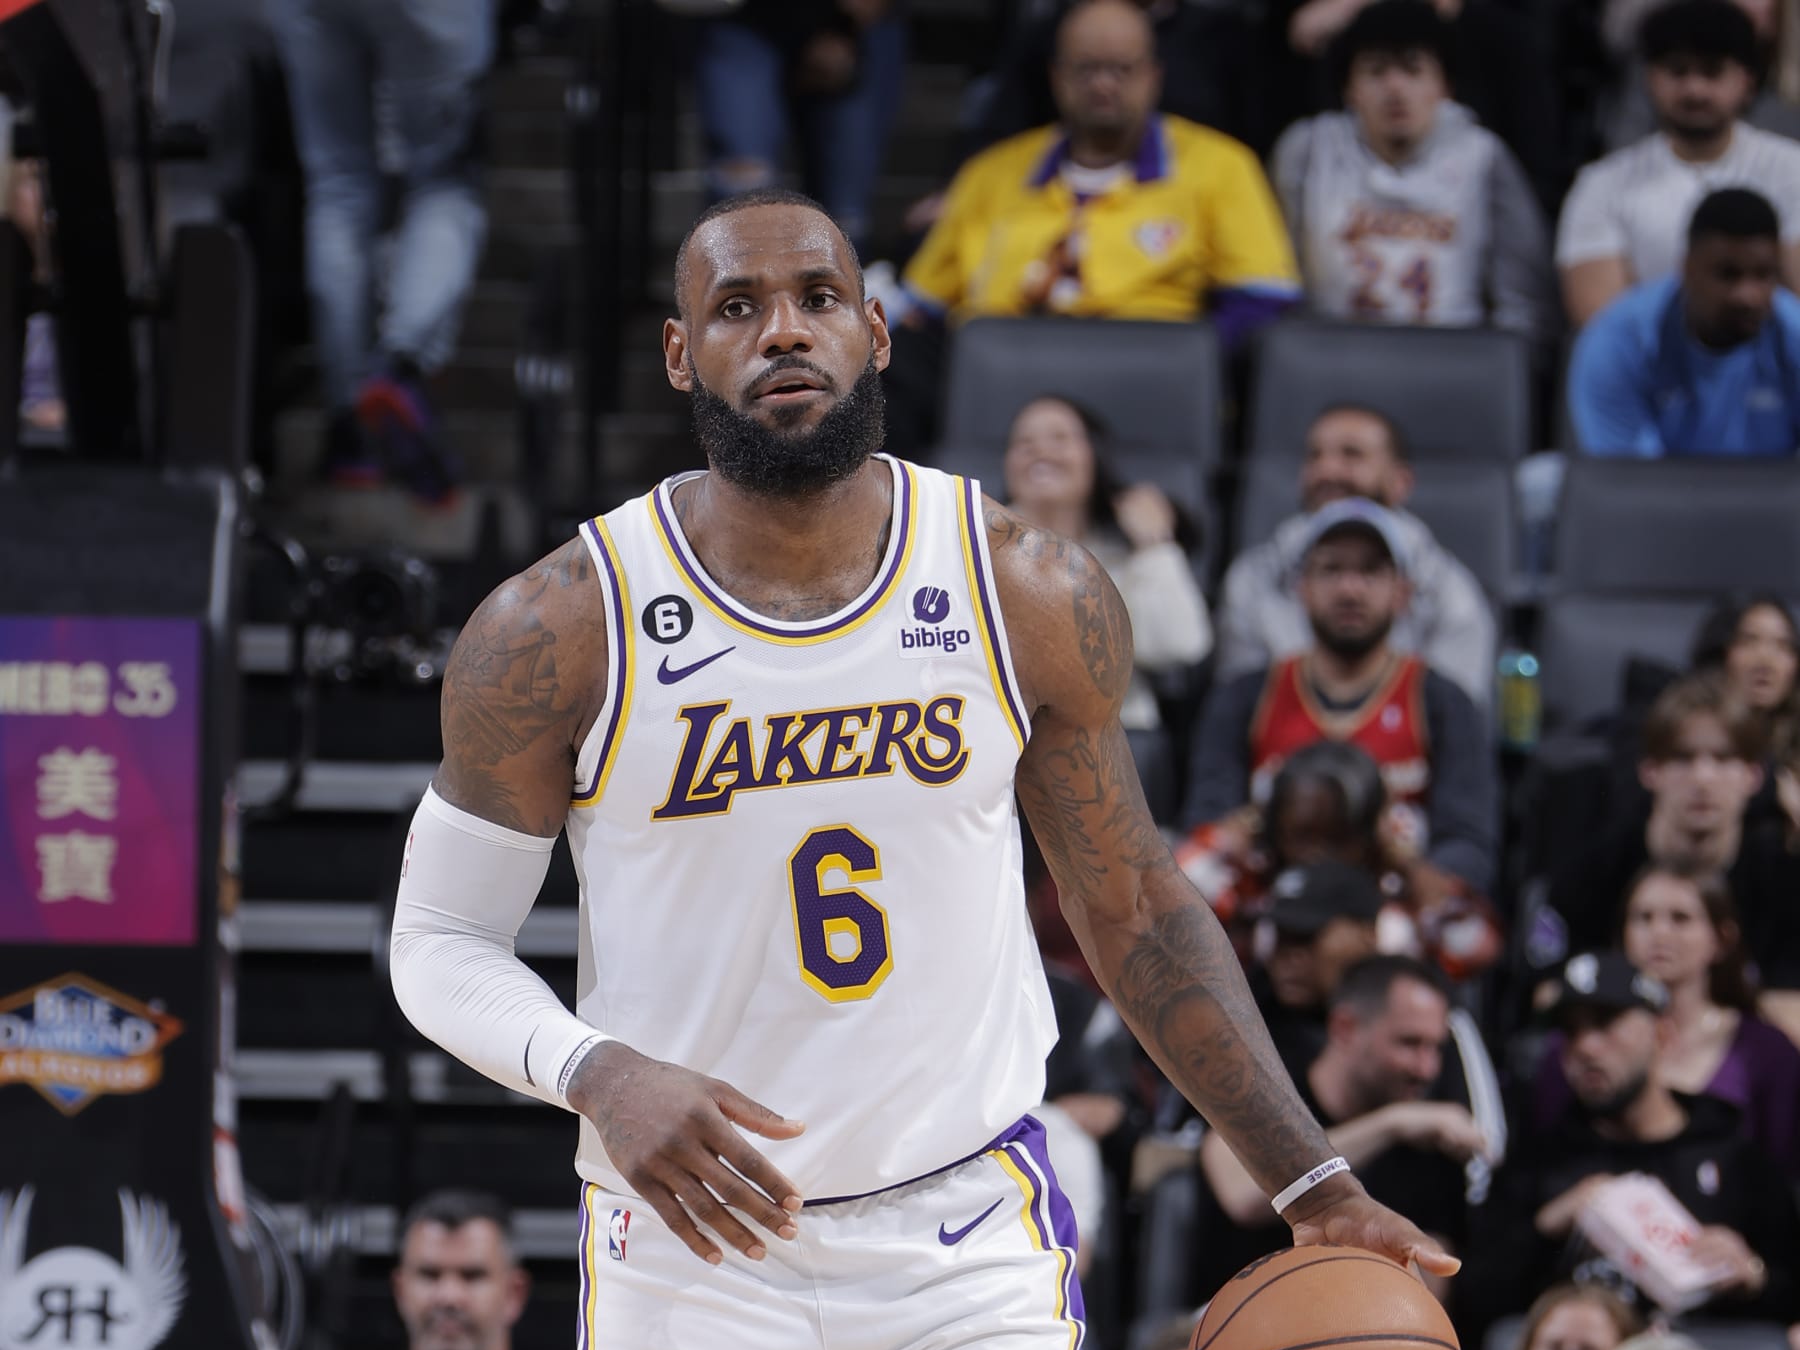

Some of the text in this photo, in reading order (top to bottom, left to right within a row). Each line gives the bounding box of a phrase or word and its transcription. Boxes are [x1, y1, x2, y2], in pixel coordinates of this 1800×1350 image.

[654, 602, 683, 639] 6
[900, 627, 971, 653] bibigo
[113, 660, 177, 718] 35
[650, 695, 972, 822] LAKERS
[787, 823, 895, 1003] 6
